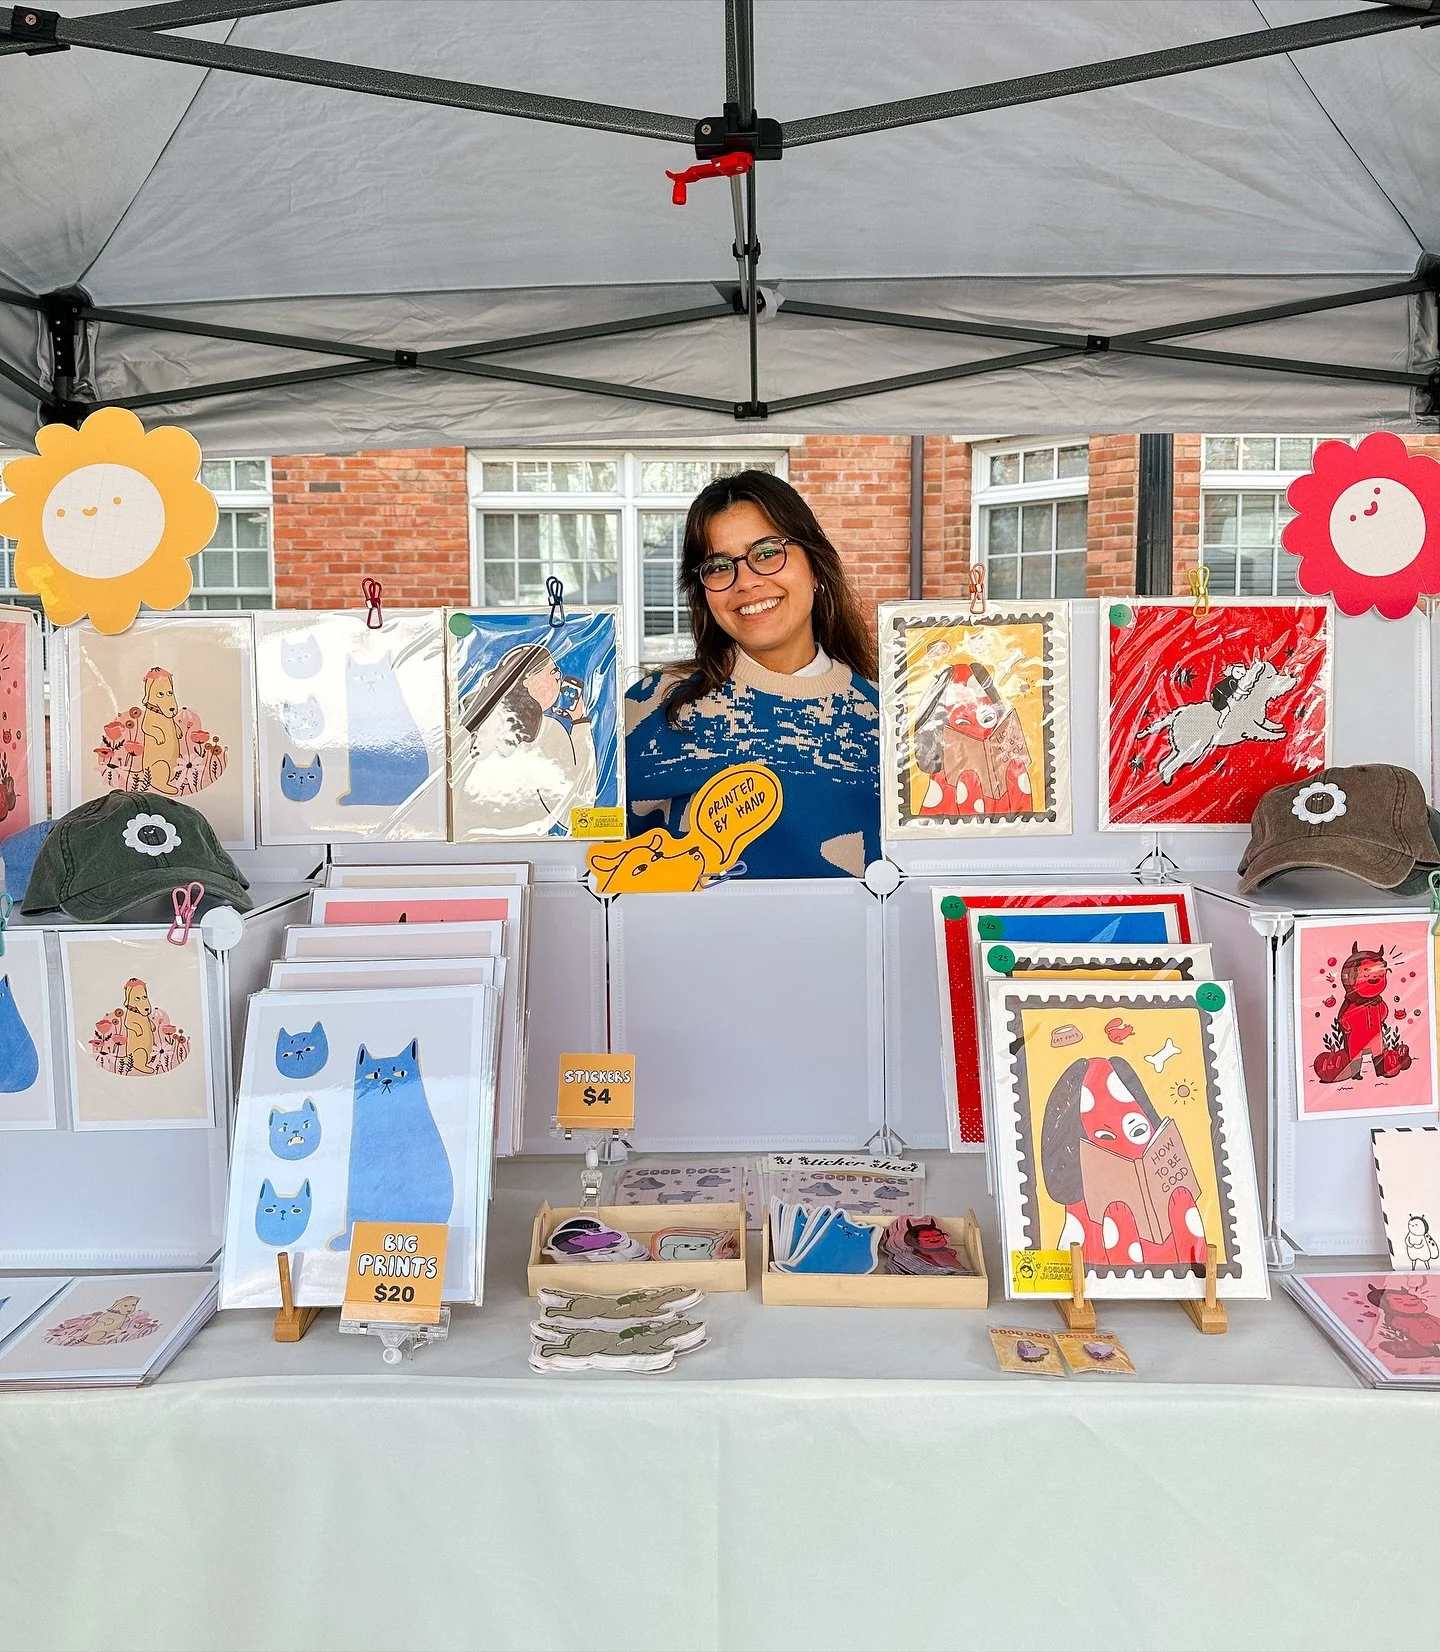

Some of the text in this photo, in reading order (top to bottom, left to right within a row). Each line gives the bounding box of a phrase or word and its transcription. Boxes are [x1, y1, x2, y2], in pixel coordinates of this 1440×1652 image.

[1002, 743, 1023, 763] GOOD
[708, 777, 755, 819] PRINTED
[714, 791, 765, 833] BY HAND
[994, 954, 1009, 962] -25
[1202, 991, 1221, 1001] -25
[563, 1069, 631, 1084] STICKERS
[583, 1086, 611, 1106] $4
[1151, 1137, 1175, 1165] HOW
[800, 1157, 865, 1166] sticker
[1155, 1153, 1181, 1179] TO BE
[635, 1168, 681, 1176] GOOD
[810, 1173, 908, 1185] GOOD DOGS
[1161, 1167, 1188, 1193] GOOD
[384, 1233, 418, 1253] BIG
[358, 1253, 437, 1279] PRINTS
[374, 1283, 415, 1302] $20
[990, 1328, 1023, 1336] GOOD
